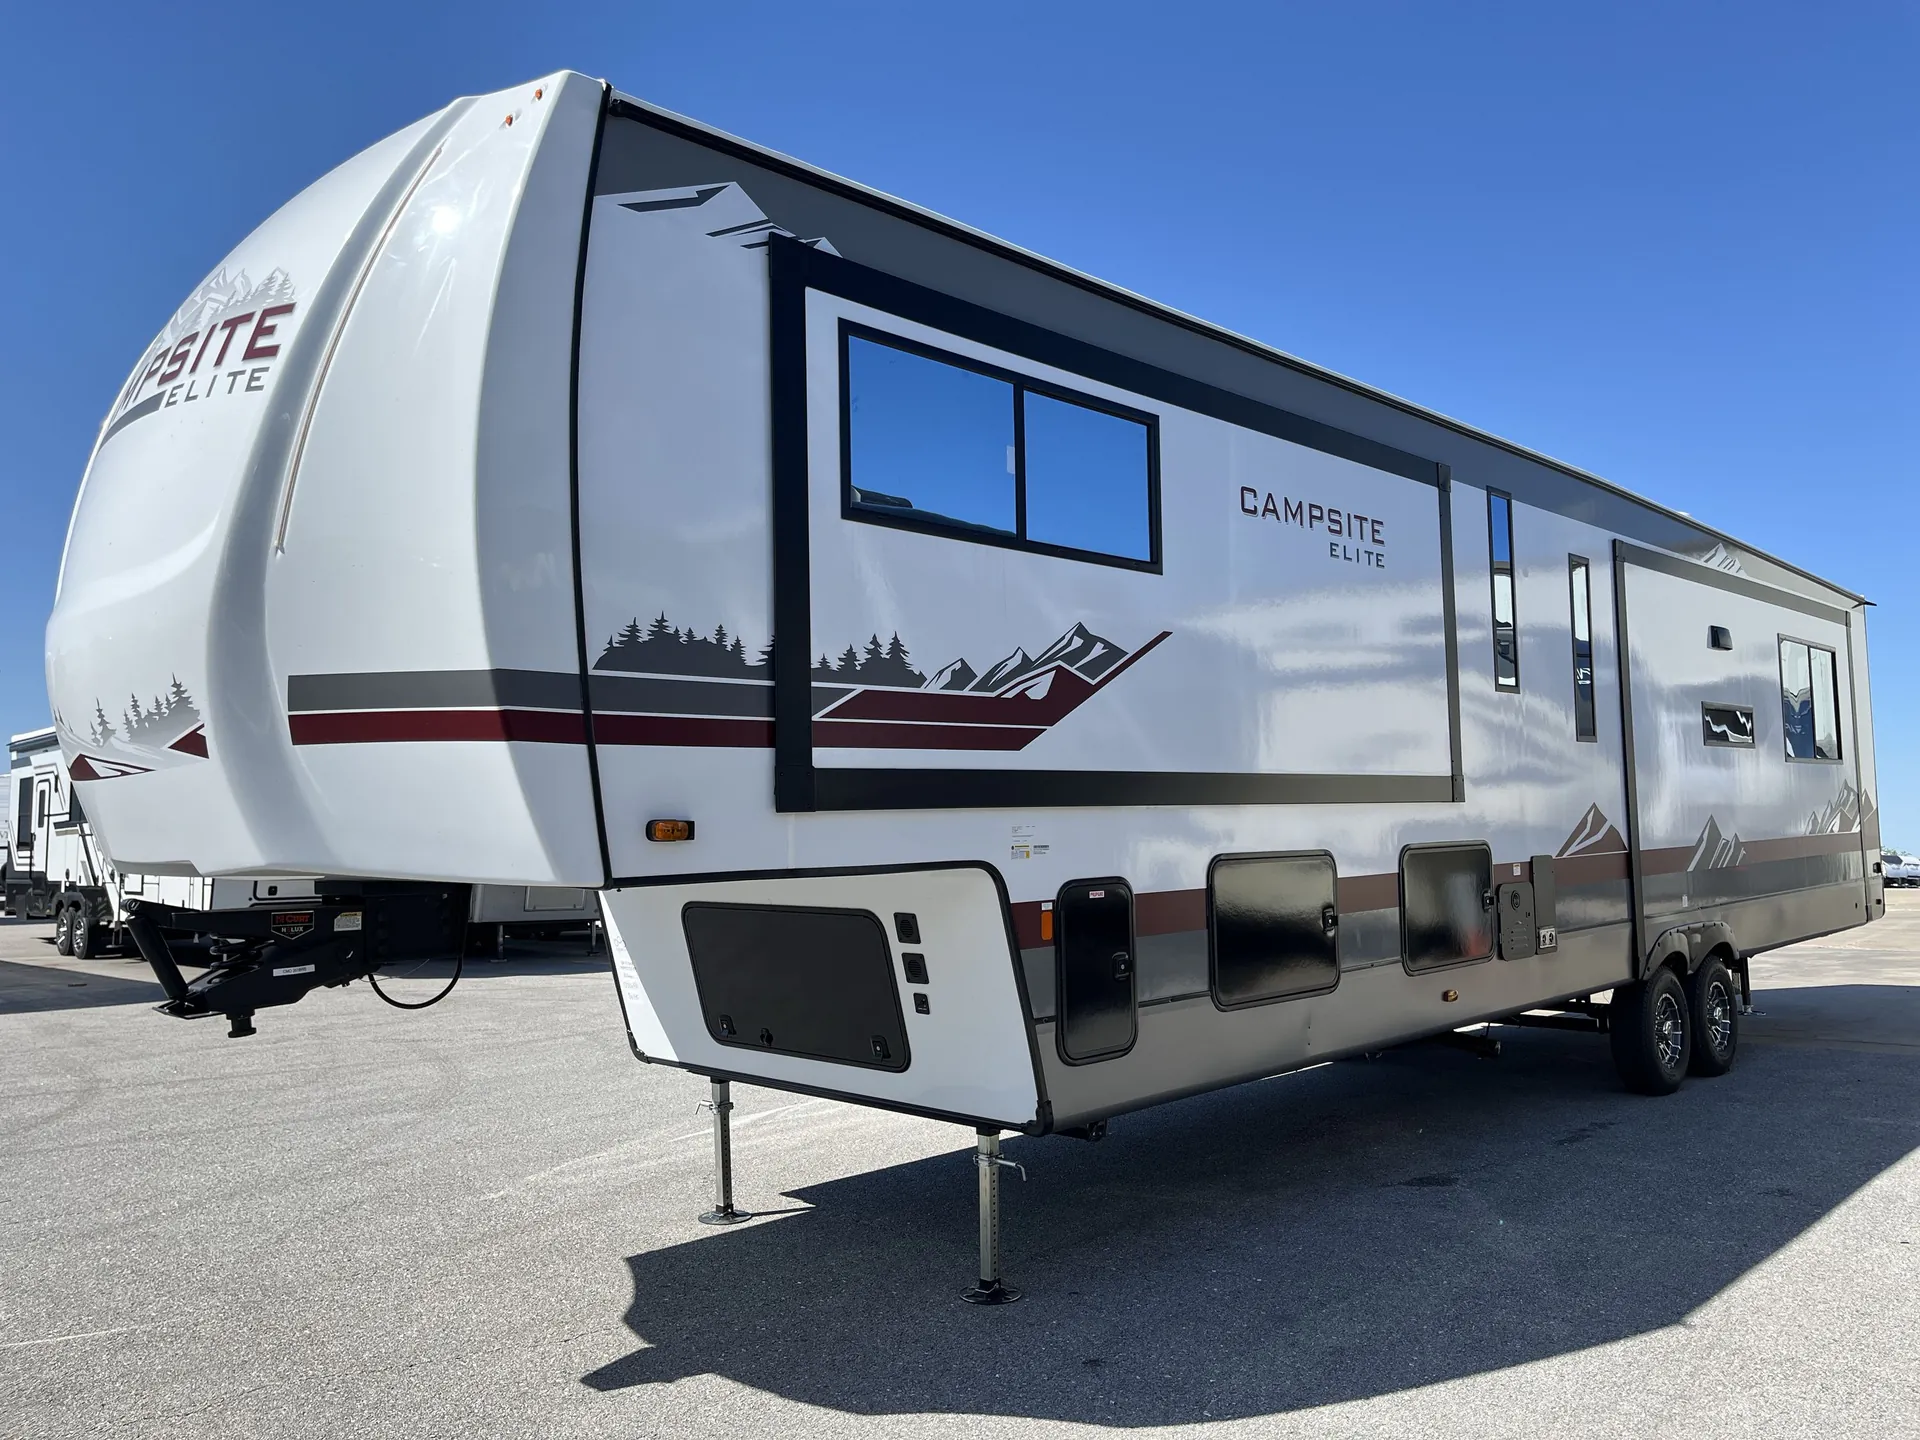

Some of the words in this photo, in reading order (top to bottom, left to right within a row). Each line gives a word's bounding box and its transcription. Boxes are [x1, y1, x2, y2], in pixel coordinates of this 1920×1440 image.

[112, 302, 296, 417] MPSITE
[164, 367, 270, 408] ELITE
[1240, 485, 1385, 546] CAMPSITE
[1329, 542, 1385, 569] ELITE
